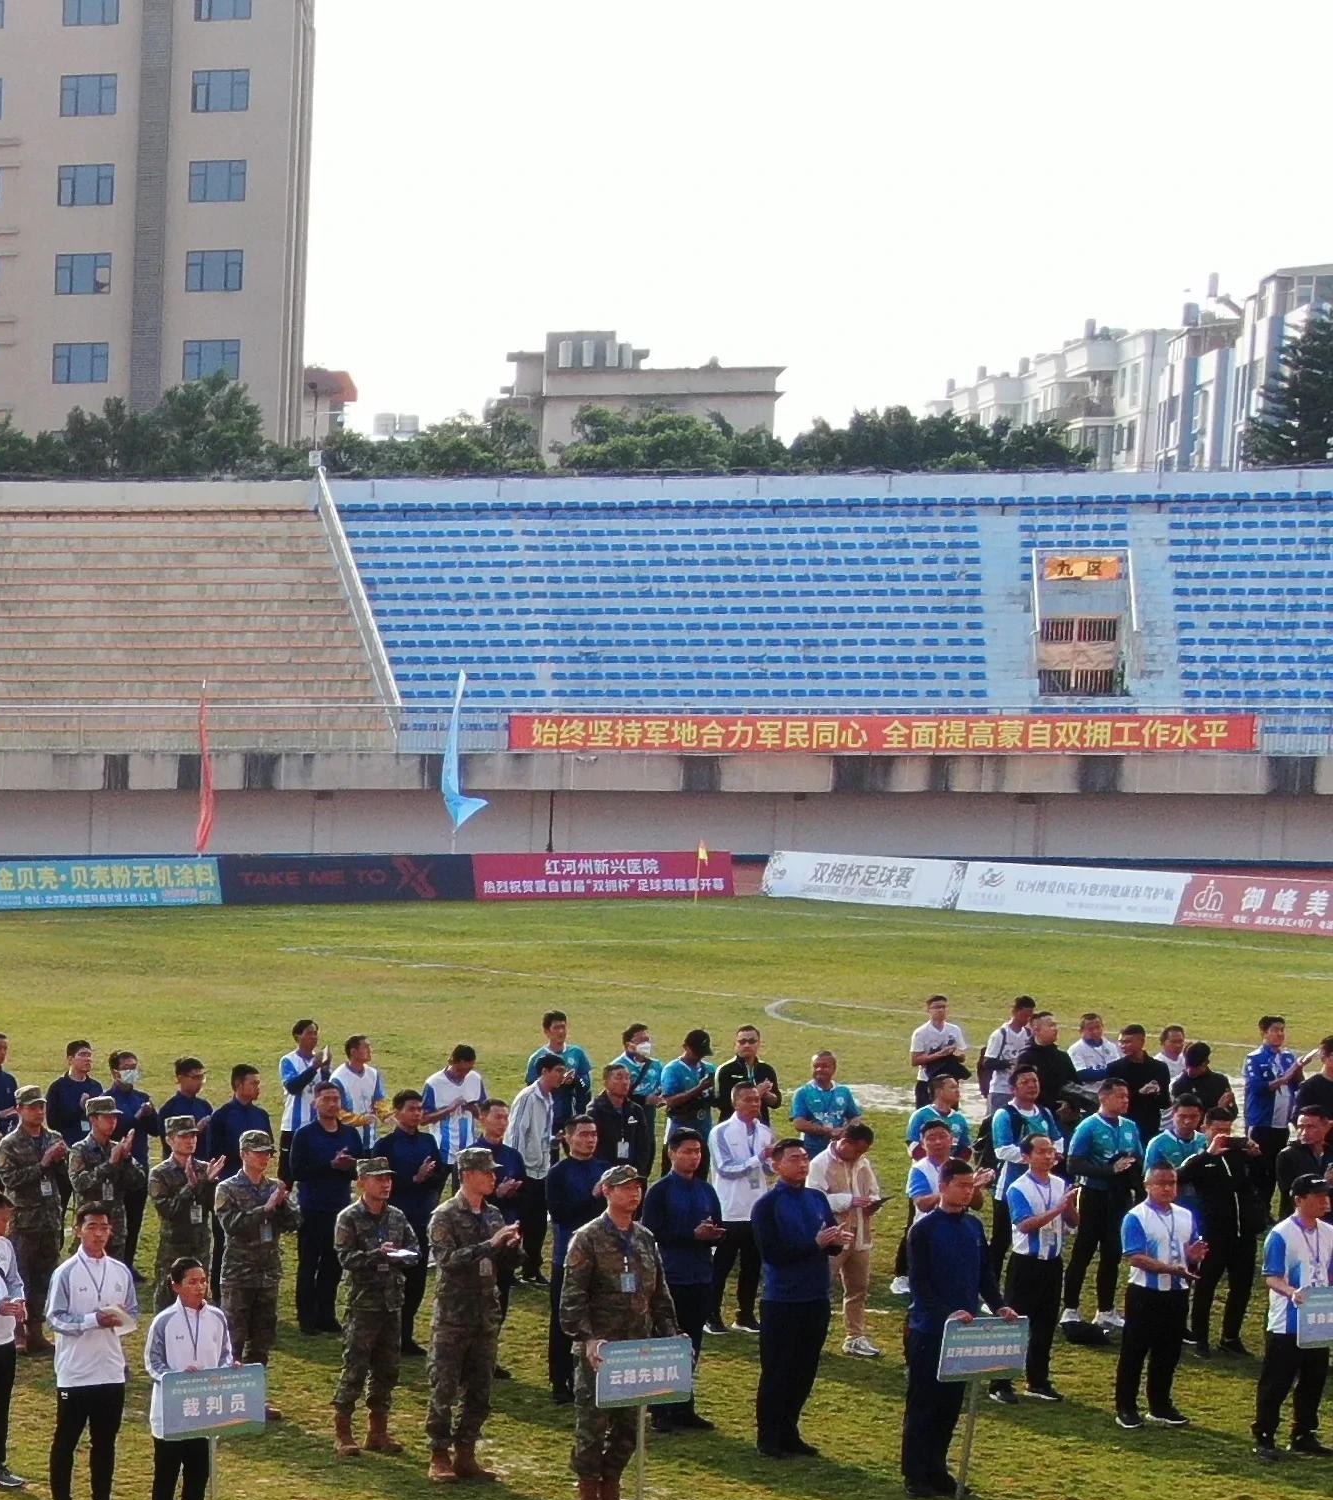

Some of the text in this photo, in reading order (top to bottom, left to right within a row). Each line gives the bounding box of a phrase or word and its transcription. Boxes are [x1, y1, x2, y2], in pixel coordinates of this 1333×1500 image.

[1056, 559, 1102, 577] 九区
[531, 719, 1229, 749] 始终坚持军地合力军民同心 全面提高蒙自双拥工作水平
[237, 870, 302, 887] TAKE
[308, 869, 345, 885] ME
[355, 868, 388, 885] TO
[544, 858, 660, 875] 红河州新兴医院
[808, 862, 916, 889] 双拥杯足球赛
[1240, 886, 1331, 917] 御峰美
[182, 1393, 246, 1417] 裁判员
